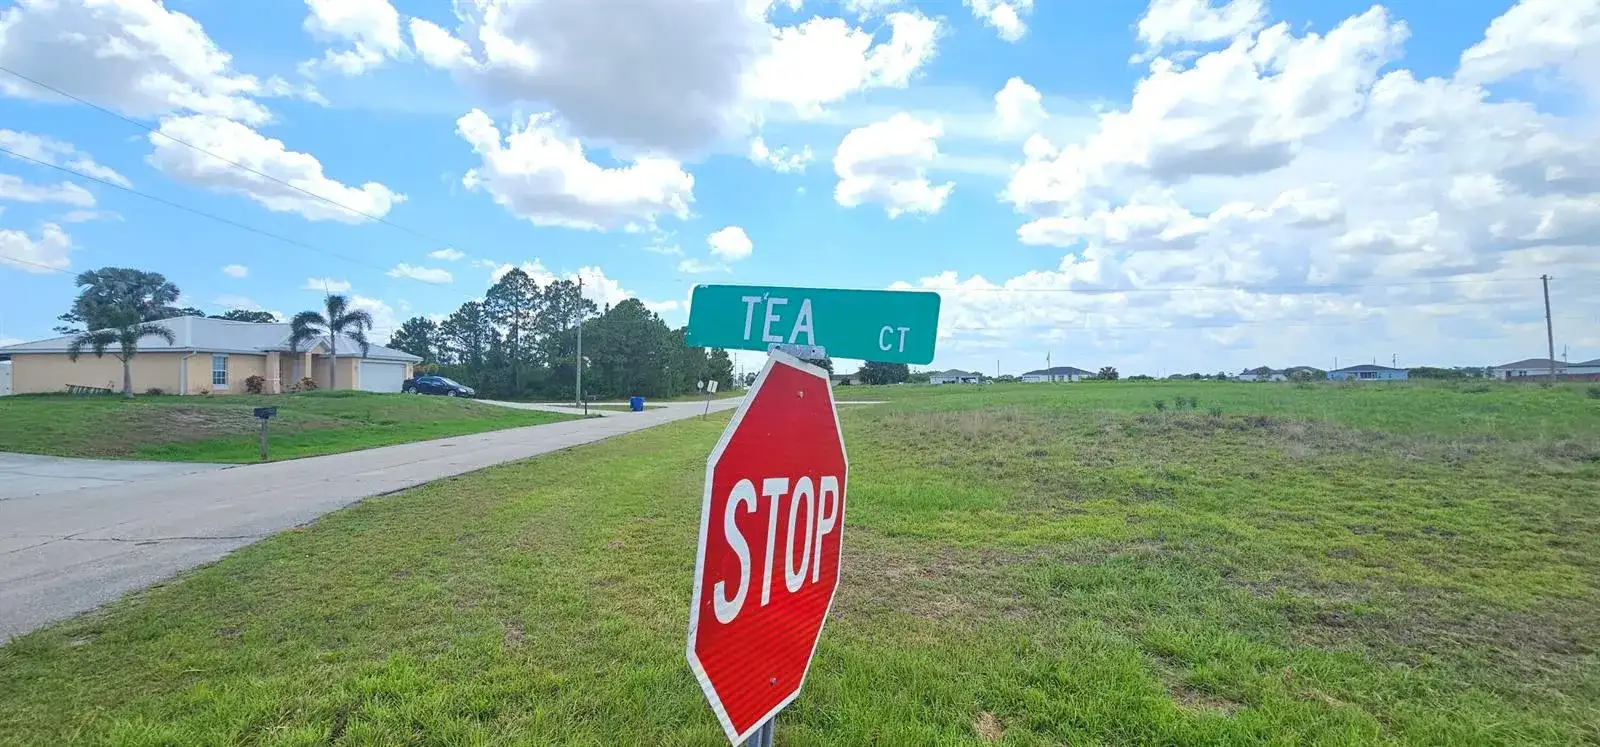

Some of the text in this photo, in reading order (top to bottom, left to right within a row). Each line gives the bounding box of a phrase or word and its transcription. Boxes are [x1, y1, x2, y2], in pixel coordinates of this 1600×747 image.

[741, 296, 911, 353] TEA CT
[713, 475, 840, 625] STOP
